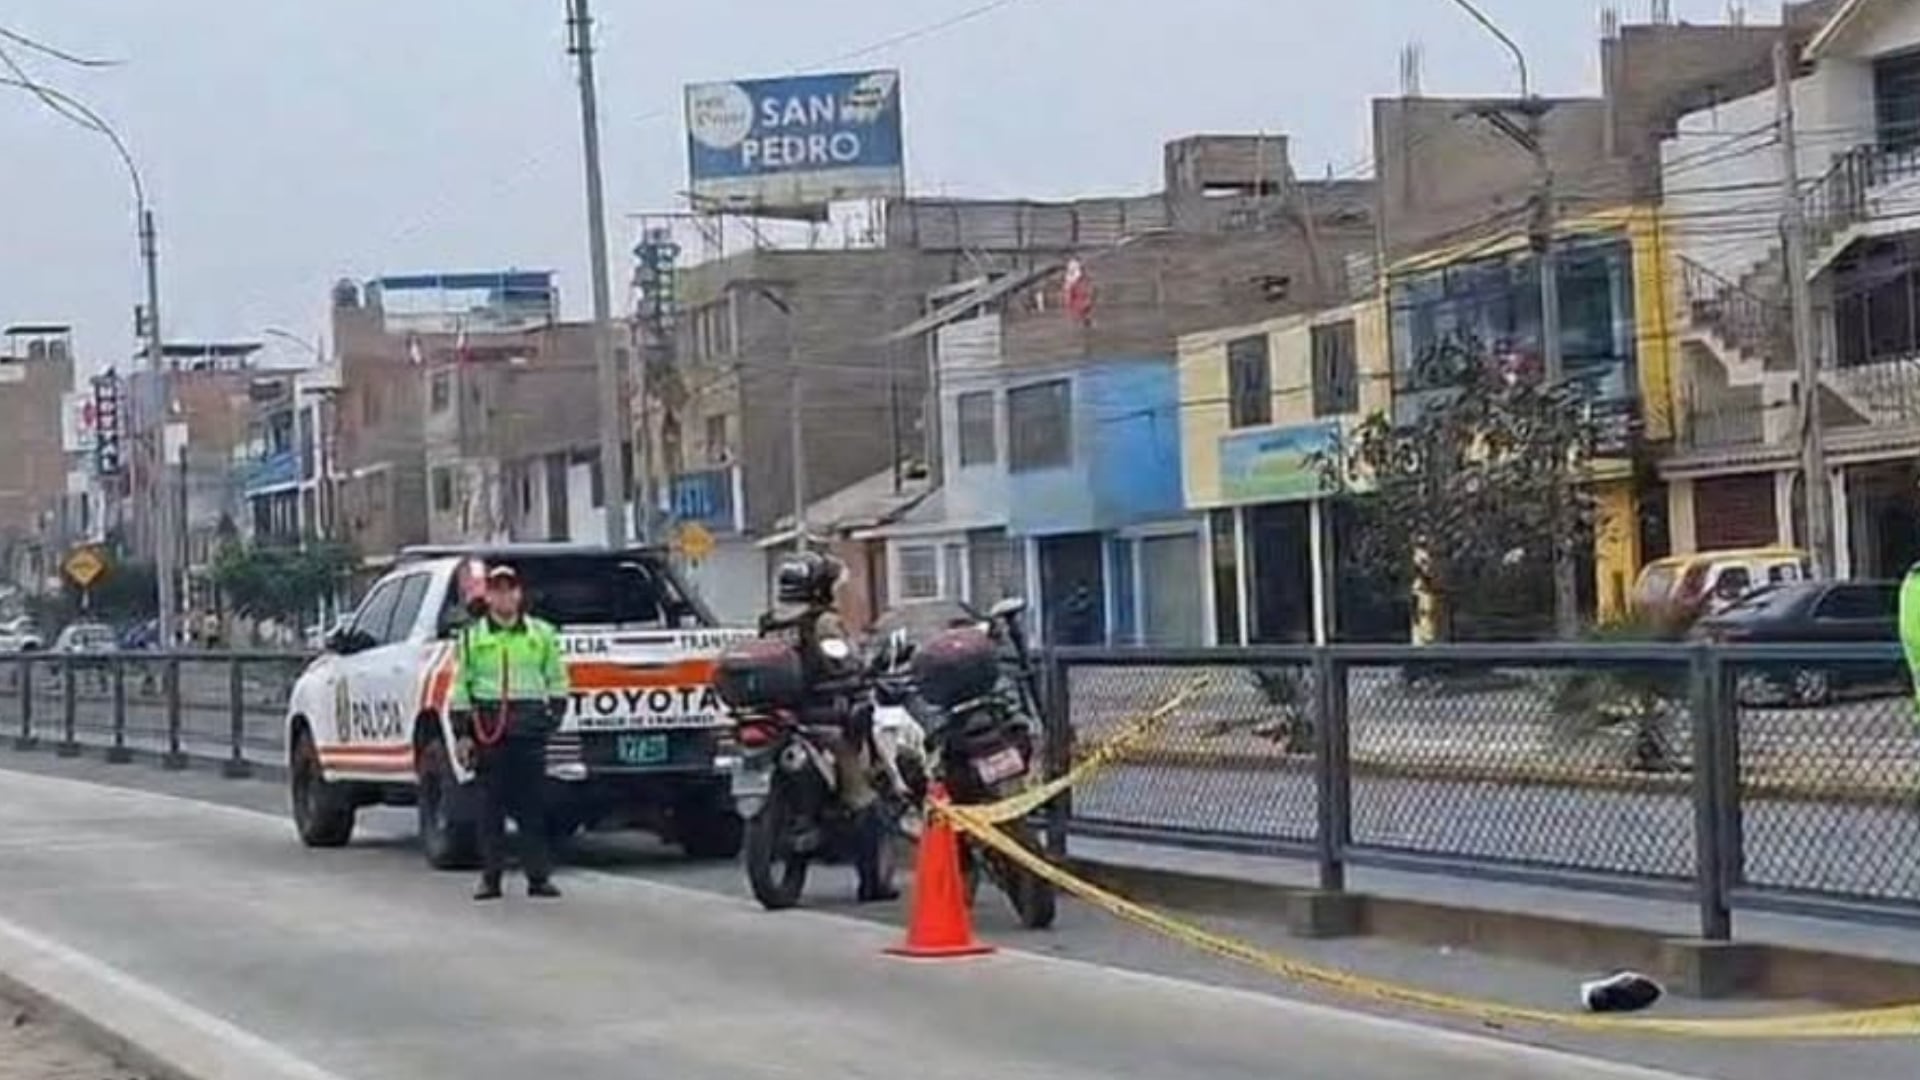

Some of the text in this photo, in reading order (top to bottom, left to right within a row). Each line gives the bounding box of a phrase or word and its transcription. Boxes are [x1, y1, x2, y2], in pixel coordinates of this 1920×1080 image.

[761, 94, 834, 126] SAN
[741, 131, 860, 168] PEDRO
[569, 686, 720, 716] TOYOTA
